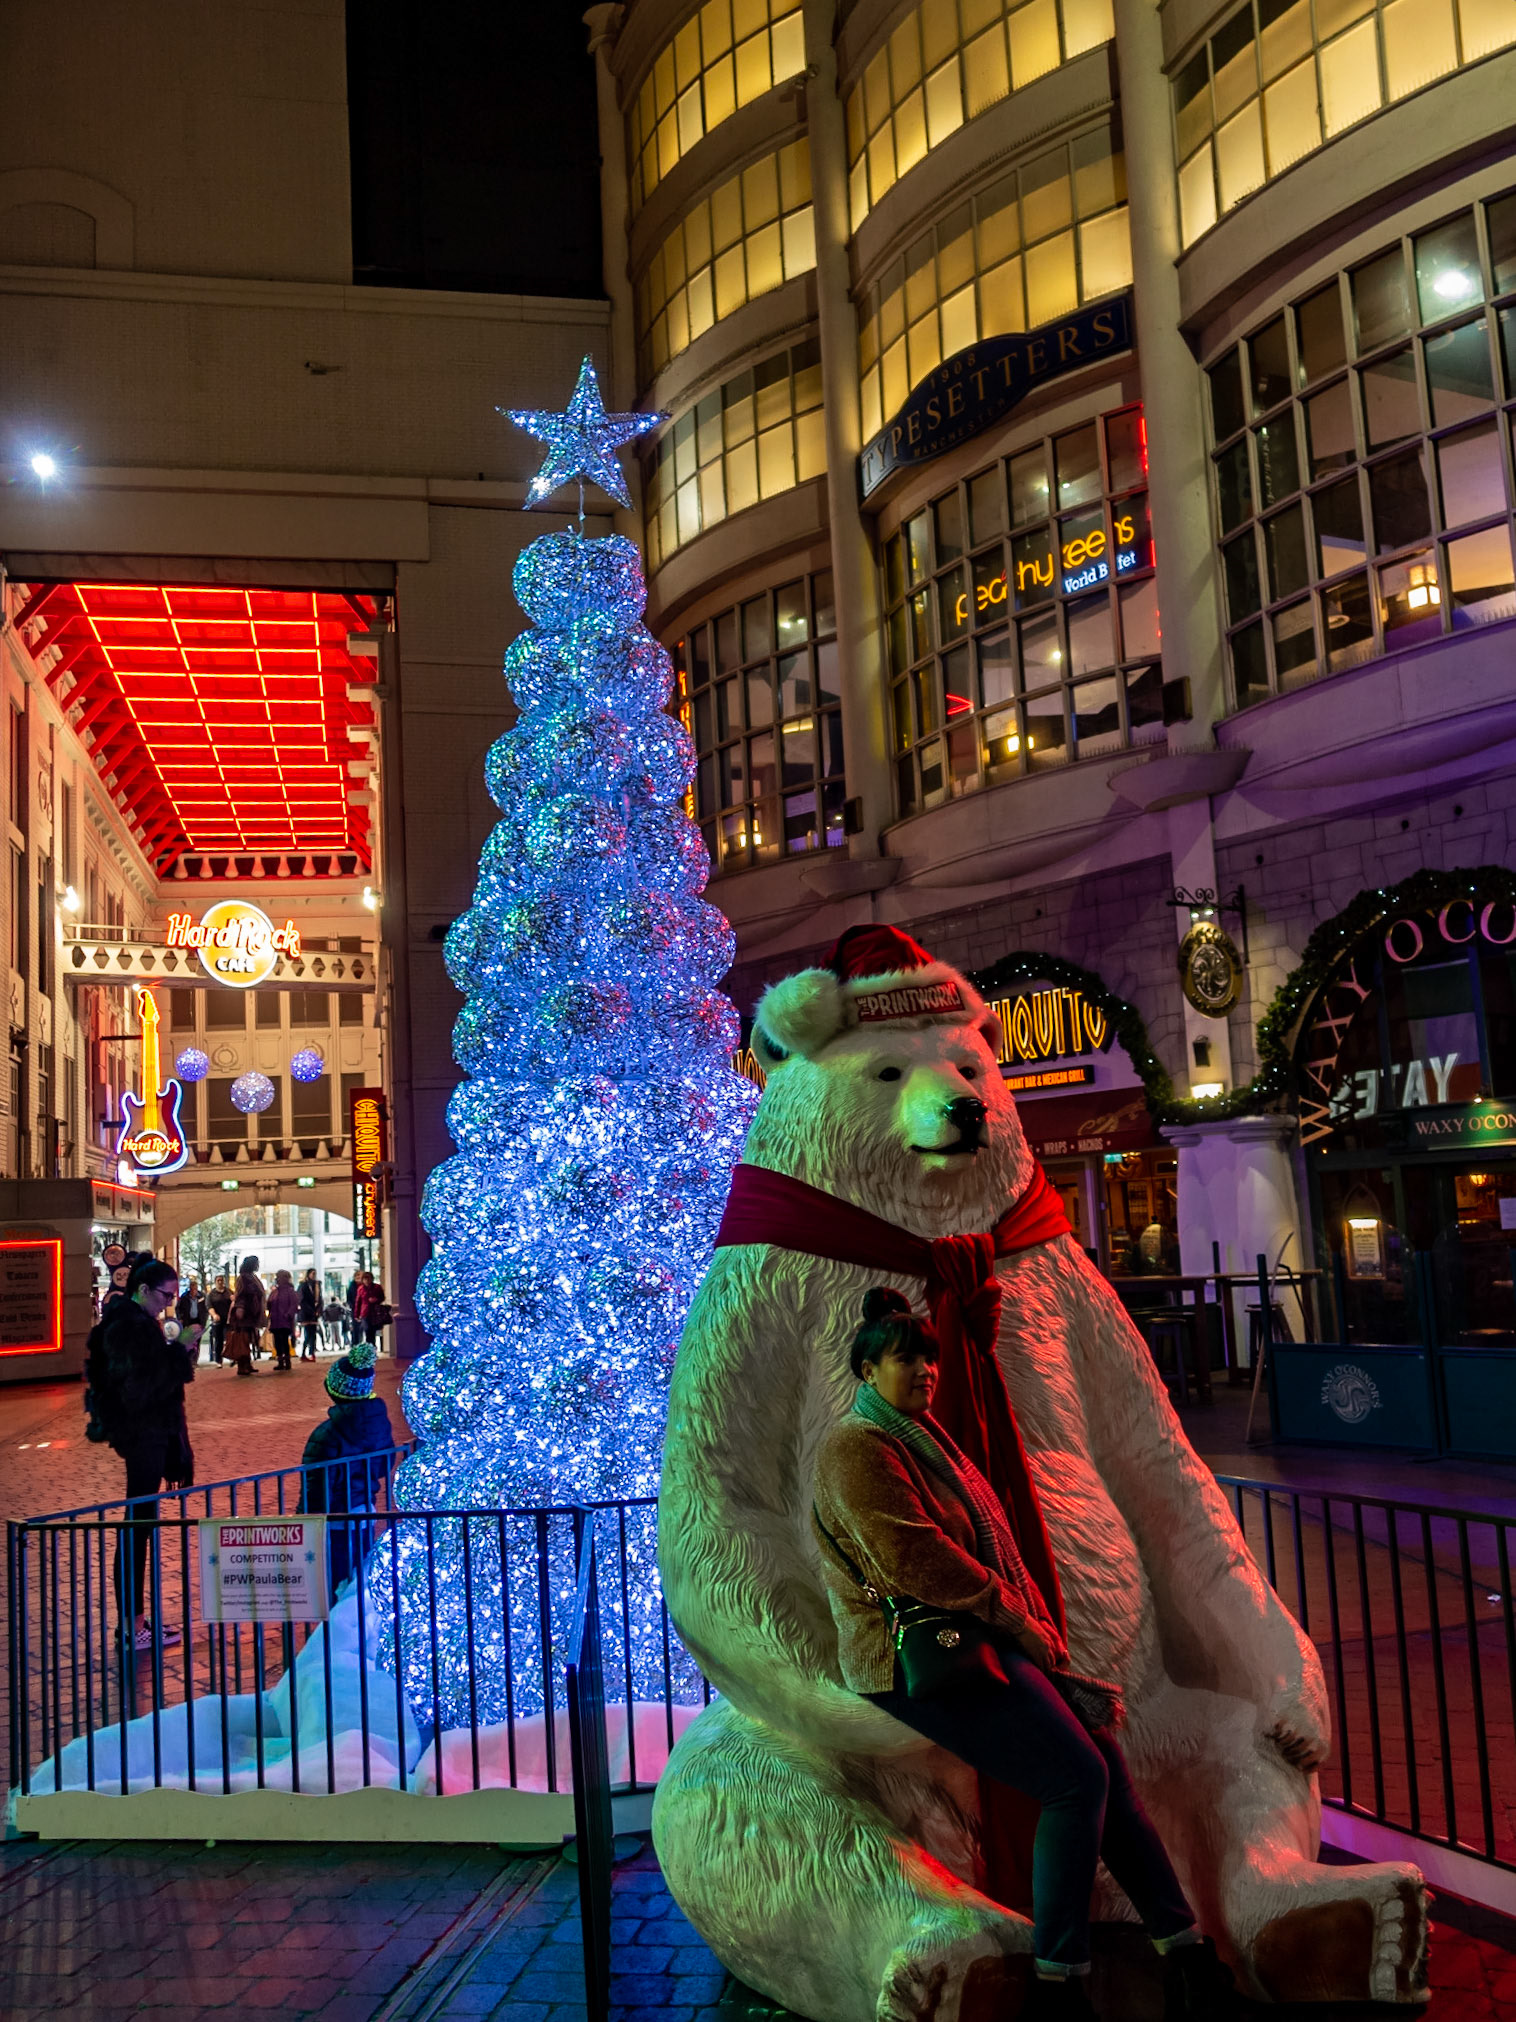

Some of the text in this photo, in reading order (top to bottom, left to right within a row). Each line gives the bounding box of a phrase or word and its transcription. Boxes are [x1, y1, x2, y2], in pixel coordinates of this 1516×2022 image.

[862, 311, 1116, 487] TYPESETTERS
[167, 913, 301, 958] Hard Rock
[215, 957, 256, 973] CAFE
[1298, 956, 1372, 1147] WAXY
[1025, 1075, 1037, 1088] BAR
[1042, 1071, 1068, 1086] MEXICAN
[1068, 1069, 1085, 1083] GRILL
[1415, 1118, 1465, 1135] WAXY
[123, 1137, 180, 1153] Hard Rock
[1043, 1140, 1068, 1156] WRAPS
[1320, 1370, 1335, 1405] WAXY
[229, 1526, 301, 1545] PRINTWORKS
[230, 1553, 294, 1564] COMPETITION
[223, 1573, 303, 1585] #PWPaulaBear
